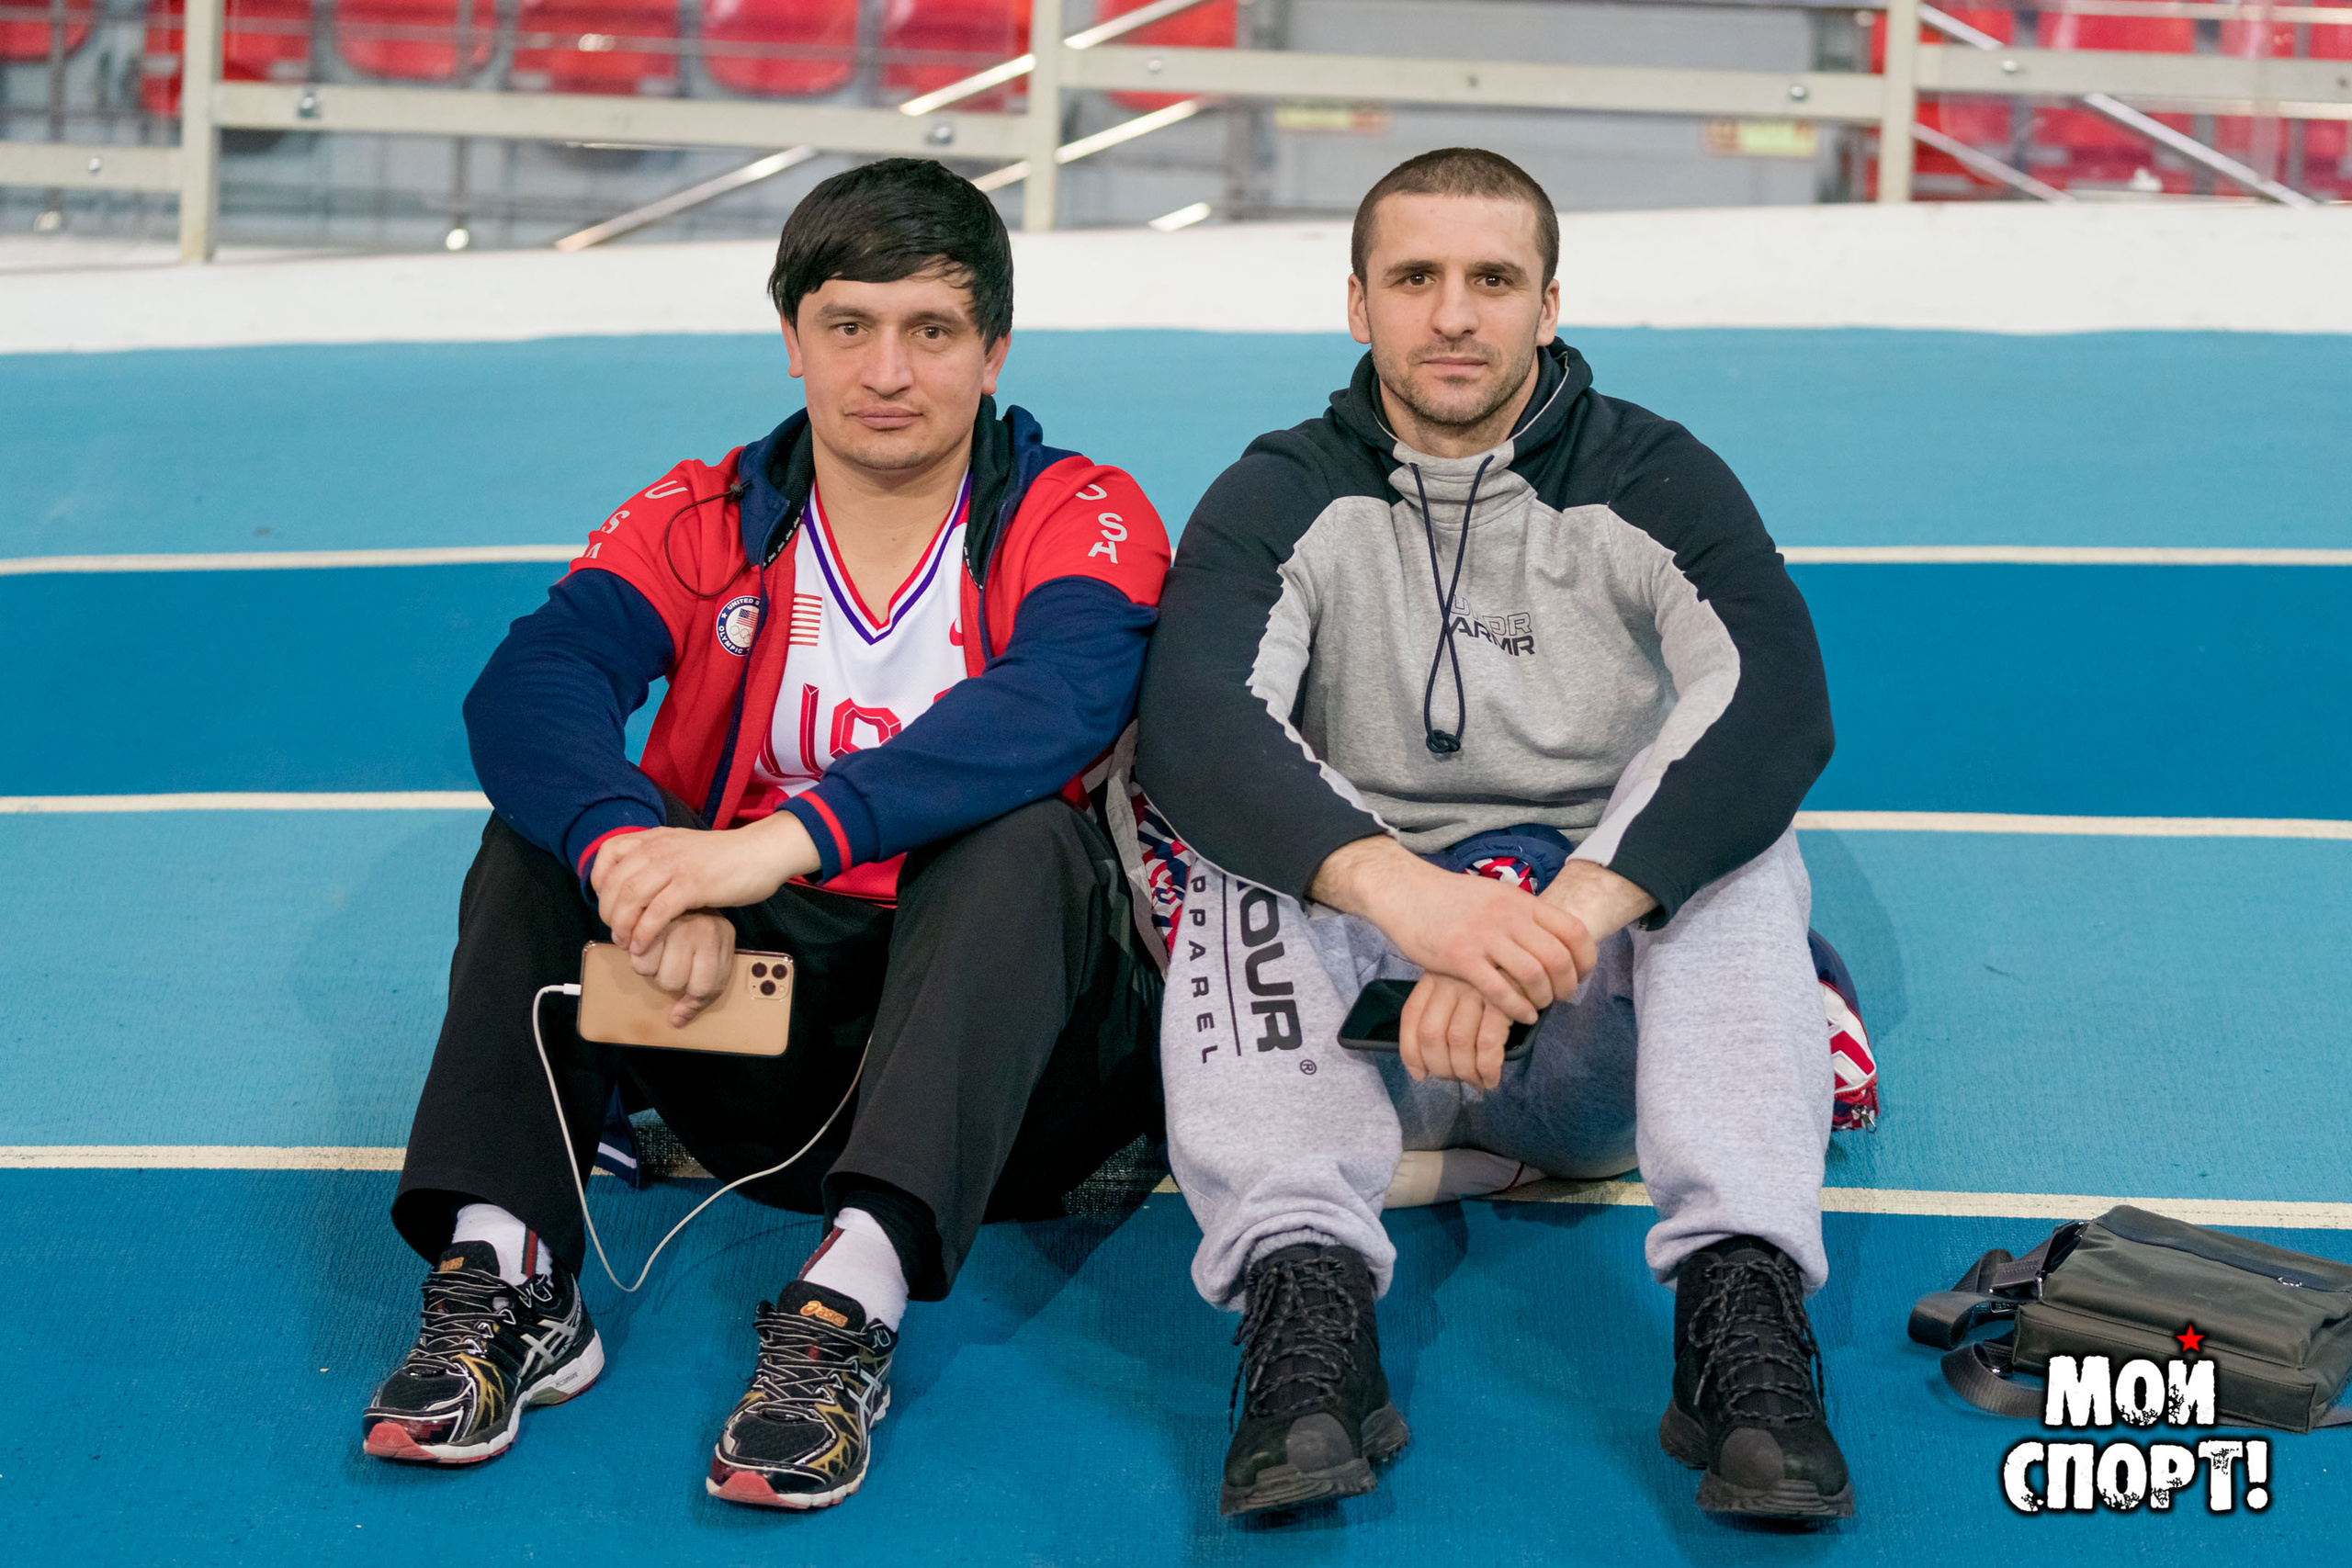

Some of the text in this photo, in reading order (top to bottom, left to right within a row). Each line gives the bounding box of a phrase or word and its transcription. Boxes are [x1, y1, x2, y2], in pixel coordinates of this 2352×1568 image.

[1074, 483, 1128, 564] USA
[718, 626, 743, 654] OLYMPIC
[727, 598, 754, 610] UNITED
[1188, 875, 1218, 1064] PPAREL
[1236, 879, 1303, 1053] OUR
